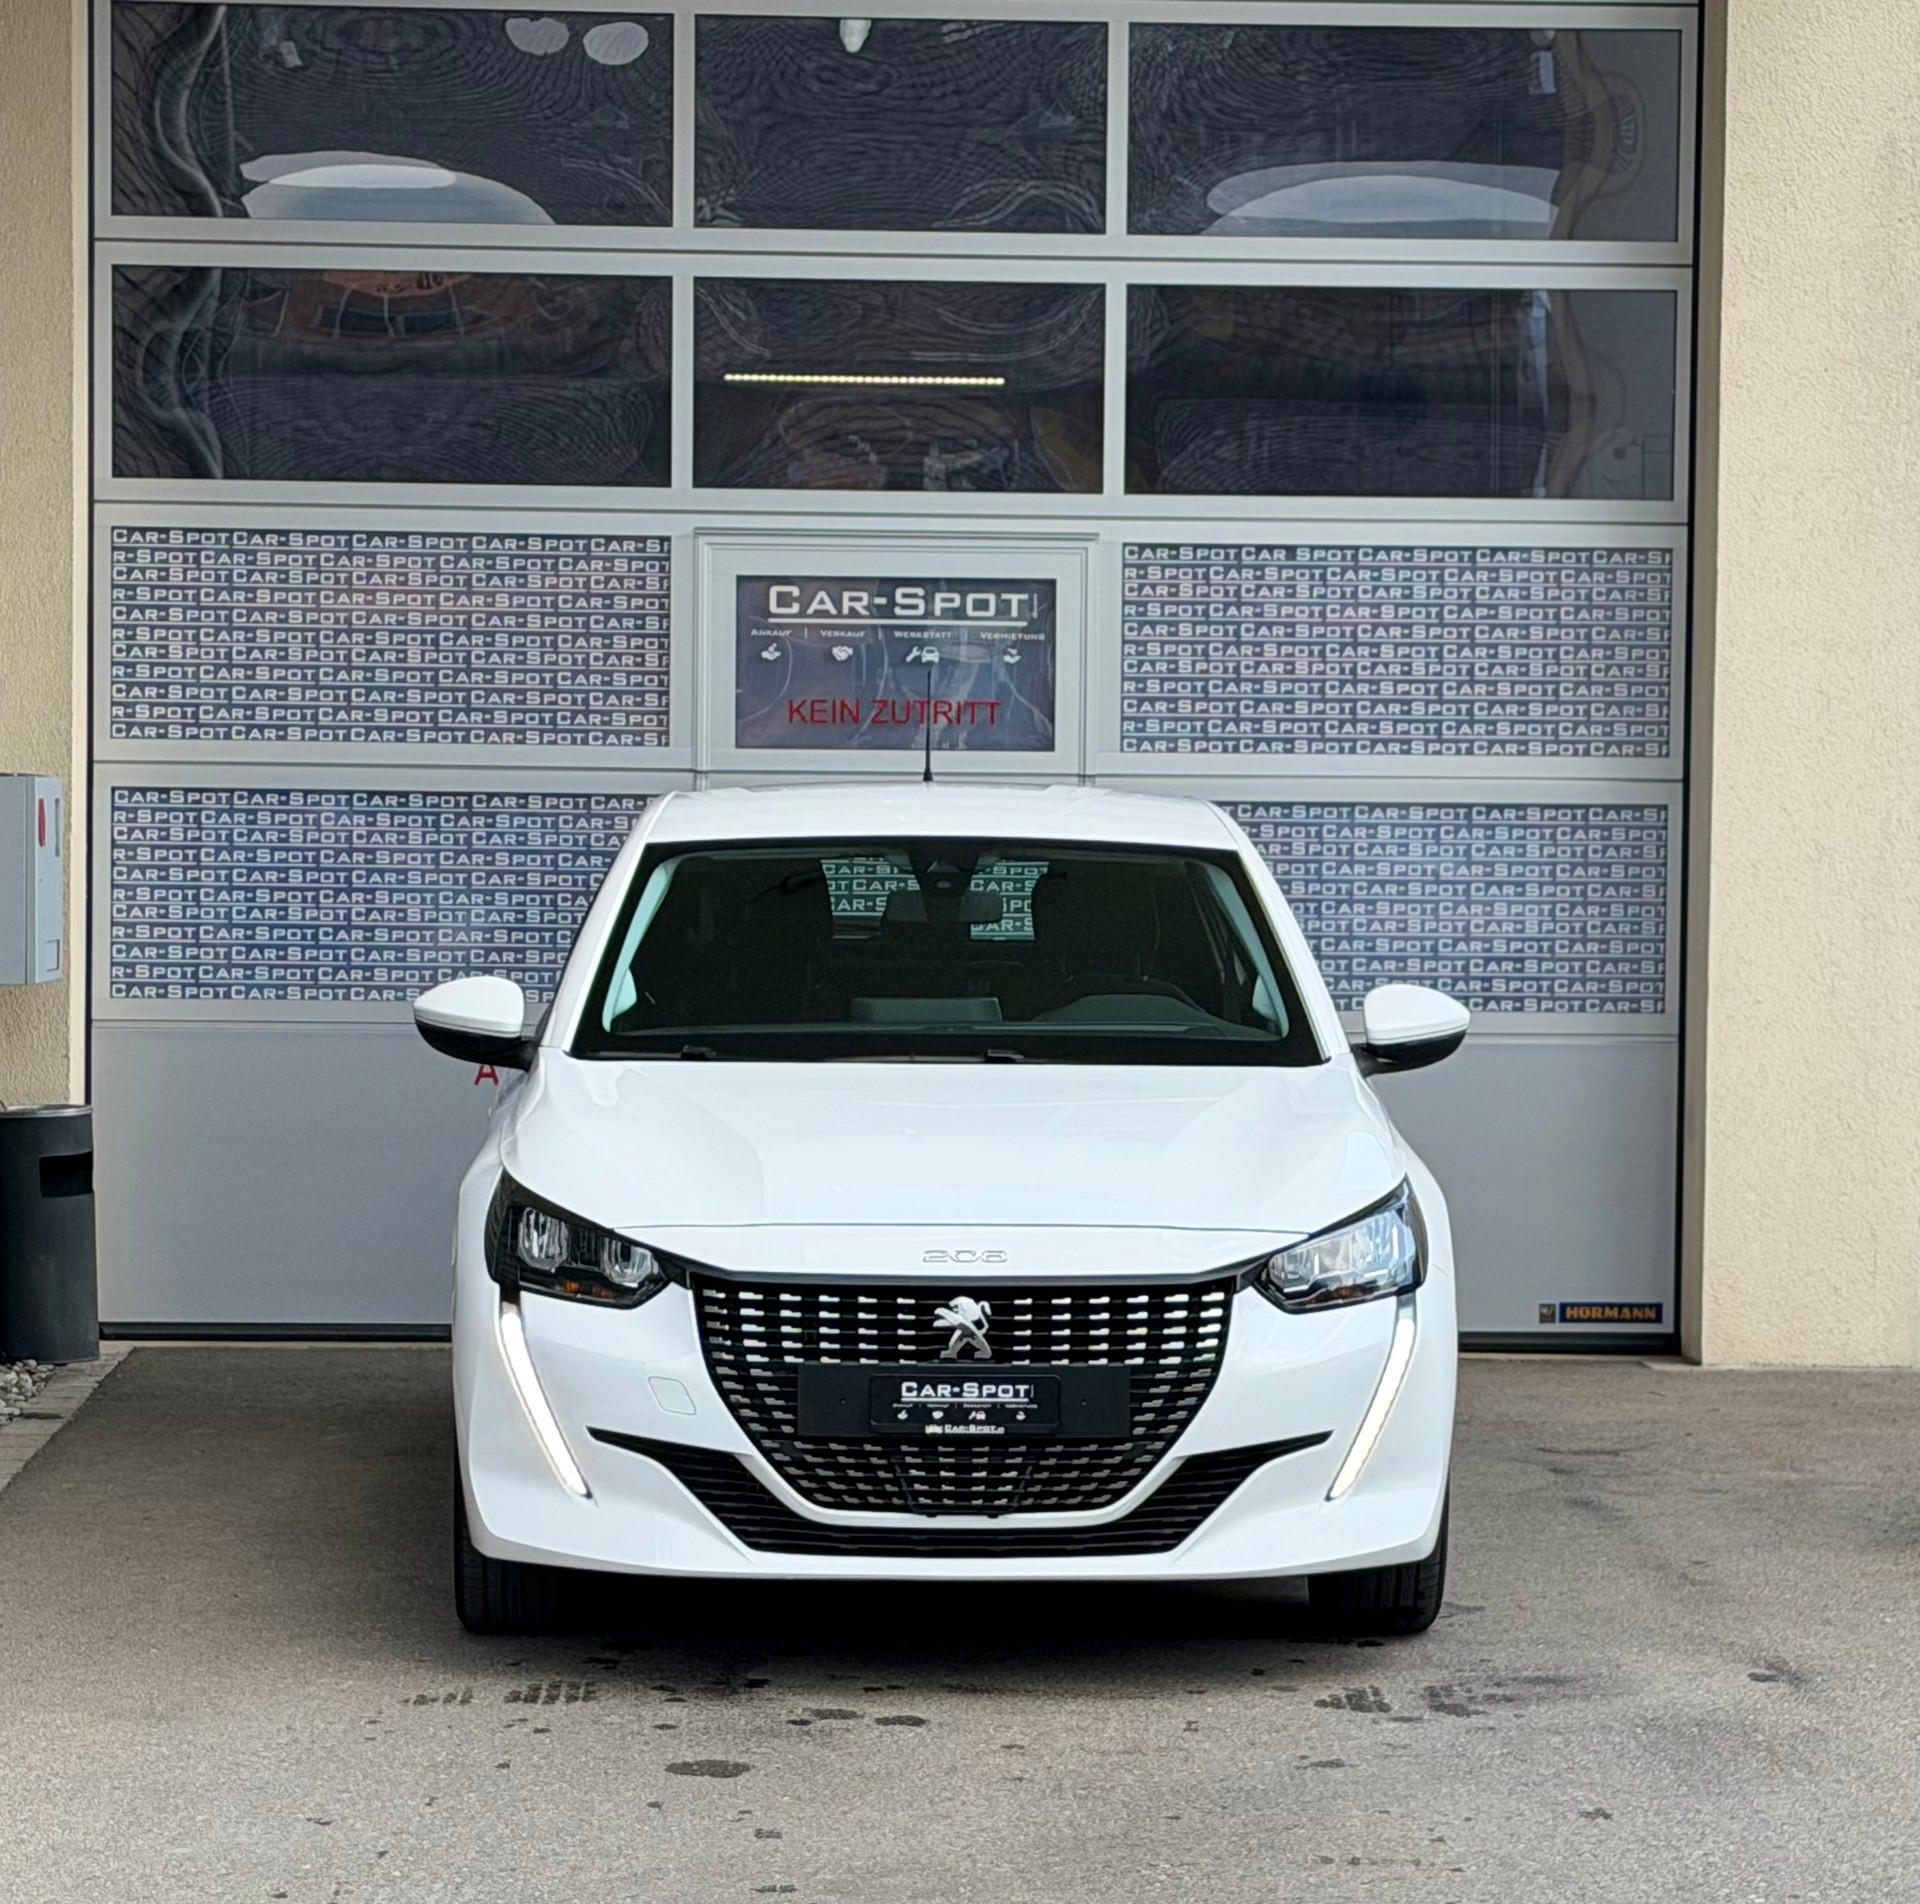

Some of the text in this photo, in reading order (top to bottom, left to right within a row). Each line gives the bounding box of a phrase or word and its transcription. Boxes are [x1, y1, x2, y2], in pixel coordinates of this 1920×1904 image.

[788, 698, 1003, 726] KEIN ZUTRITT
[922, 1250, 1008, 1262] 208
